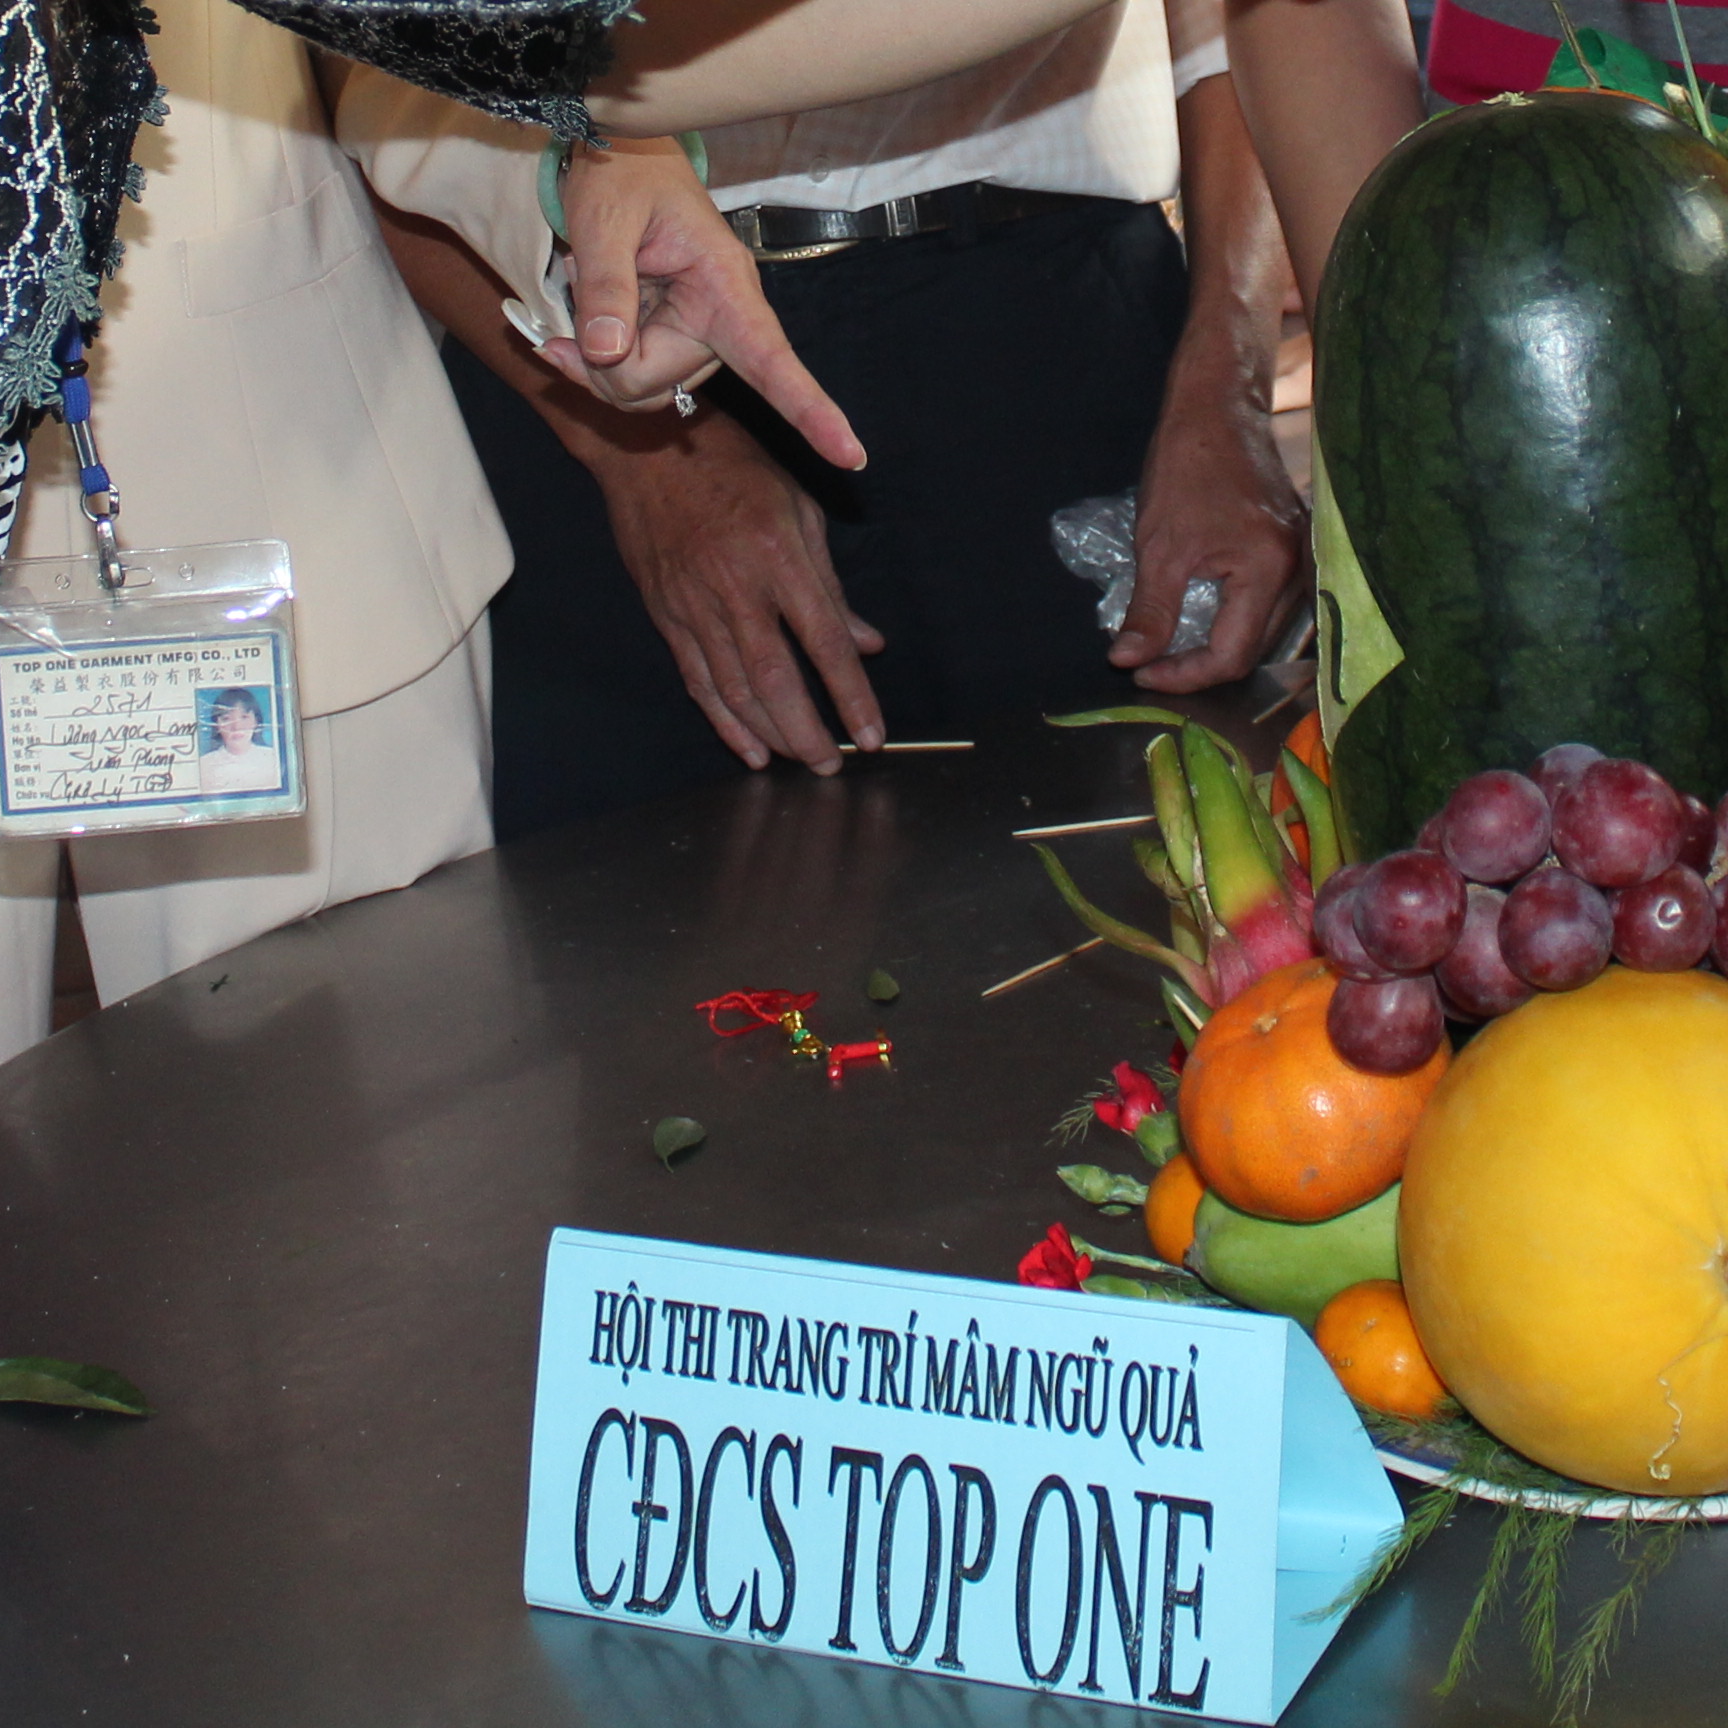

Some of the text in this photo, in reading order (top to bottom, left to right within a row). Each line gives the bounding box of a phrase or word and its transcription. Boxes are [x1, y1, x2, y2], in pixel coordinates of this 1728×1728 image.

[12, 647, 261, 674] TOP ONE GARMENT (MFG) CO., LTD
[589, 1280, 1203, 1464] HỘI THI TRANG TRÍ MÂM NGŨ QUẢ
[574, 1407, 1214, 1712] CĐCS TOP ONE
